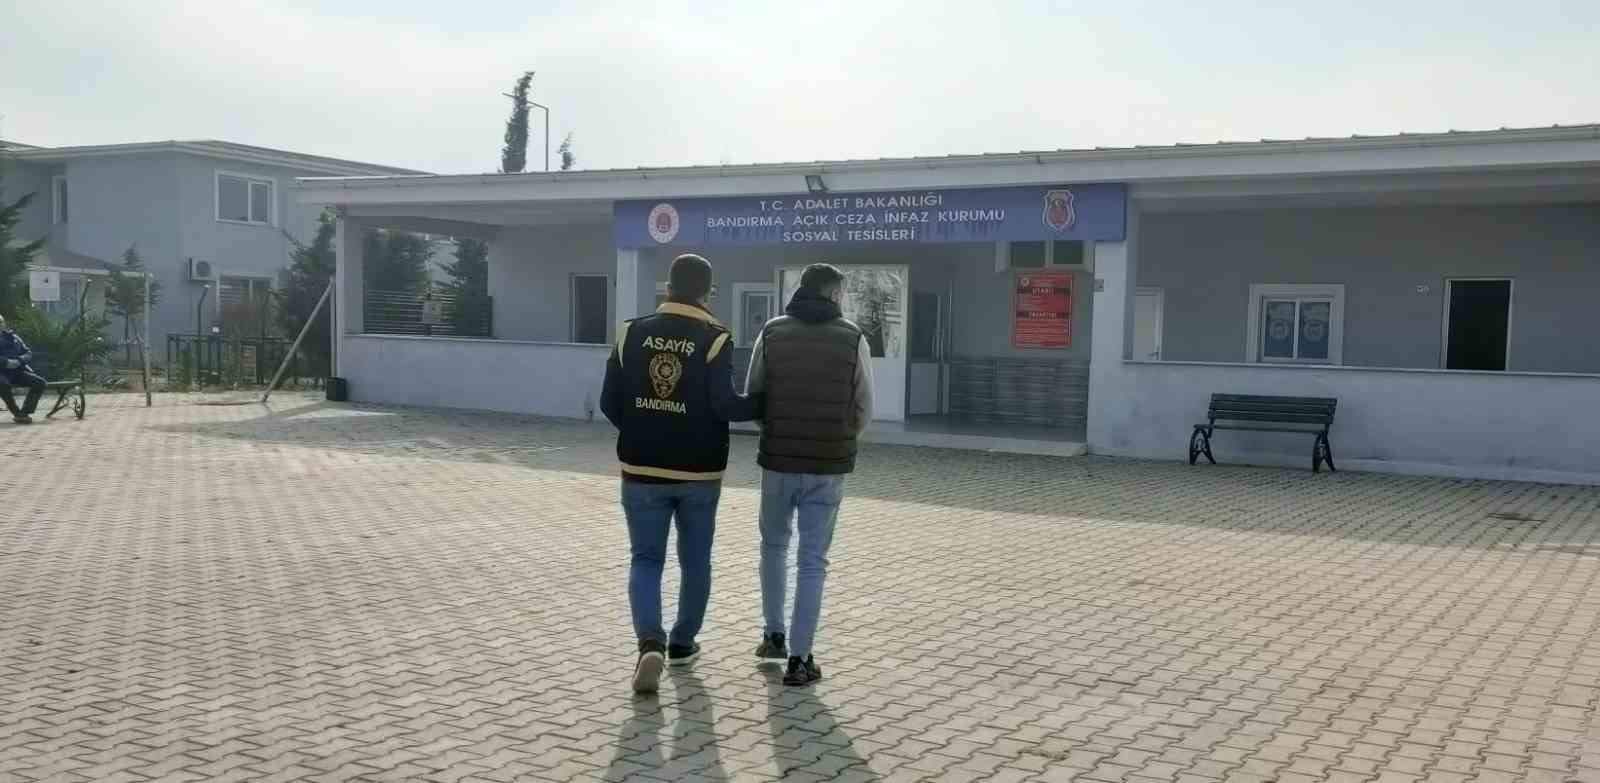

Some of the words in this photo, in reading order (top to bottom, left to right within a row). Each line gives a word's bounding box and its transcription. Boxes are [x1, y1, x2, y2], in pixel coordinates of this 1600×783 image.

[793, 198, 849, 210] ADALET
[855, 191, 943, 208] BAKANLIĞI
[707, 215, 784, 228] BANDIRMA
[792, 214, 828, 228] AÇIK
[835, 213, 877, 225] CEZA
[884, 209, 929, 224] İNFAZ
[938, 208, 1005, 222] KURUMU
[783, 231, 839, 242] SOSYAL
[847, 226, 915, 242] TESİSLERİ
[642, 336, 695, 356] ASAYİŞ
[635, 397, 687, 413] BANDIRMA
